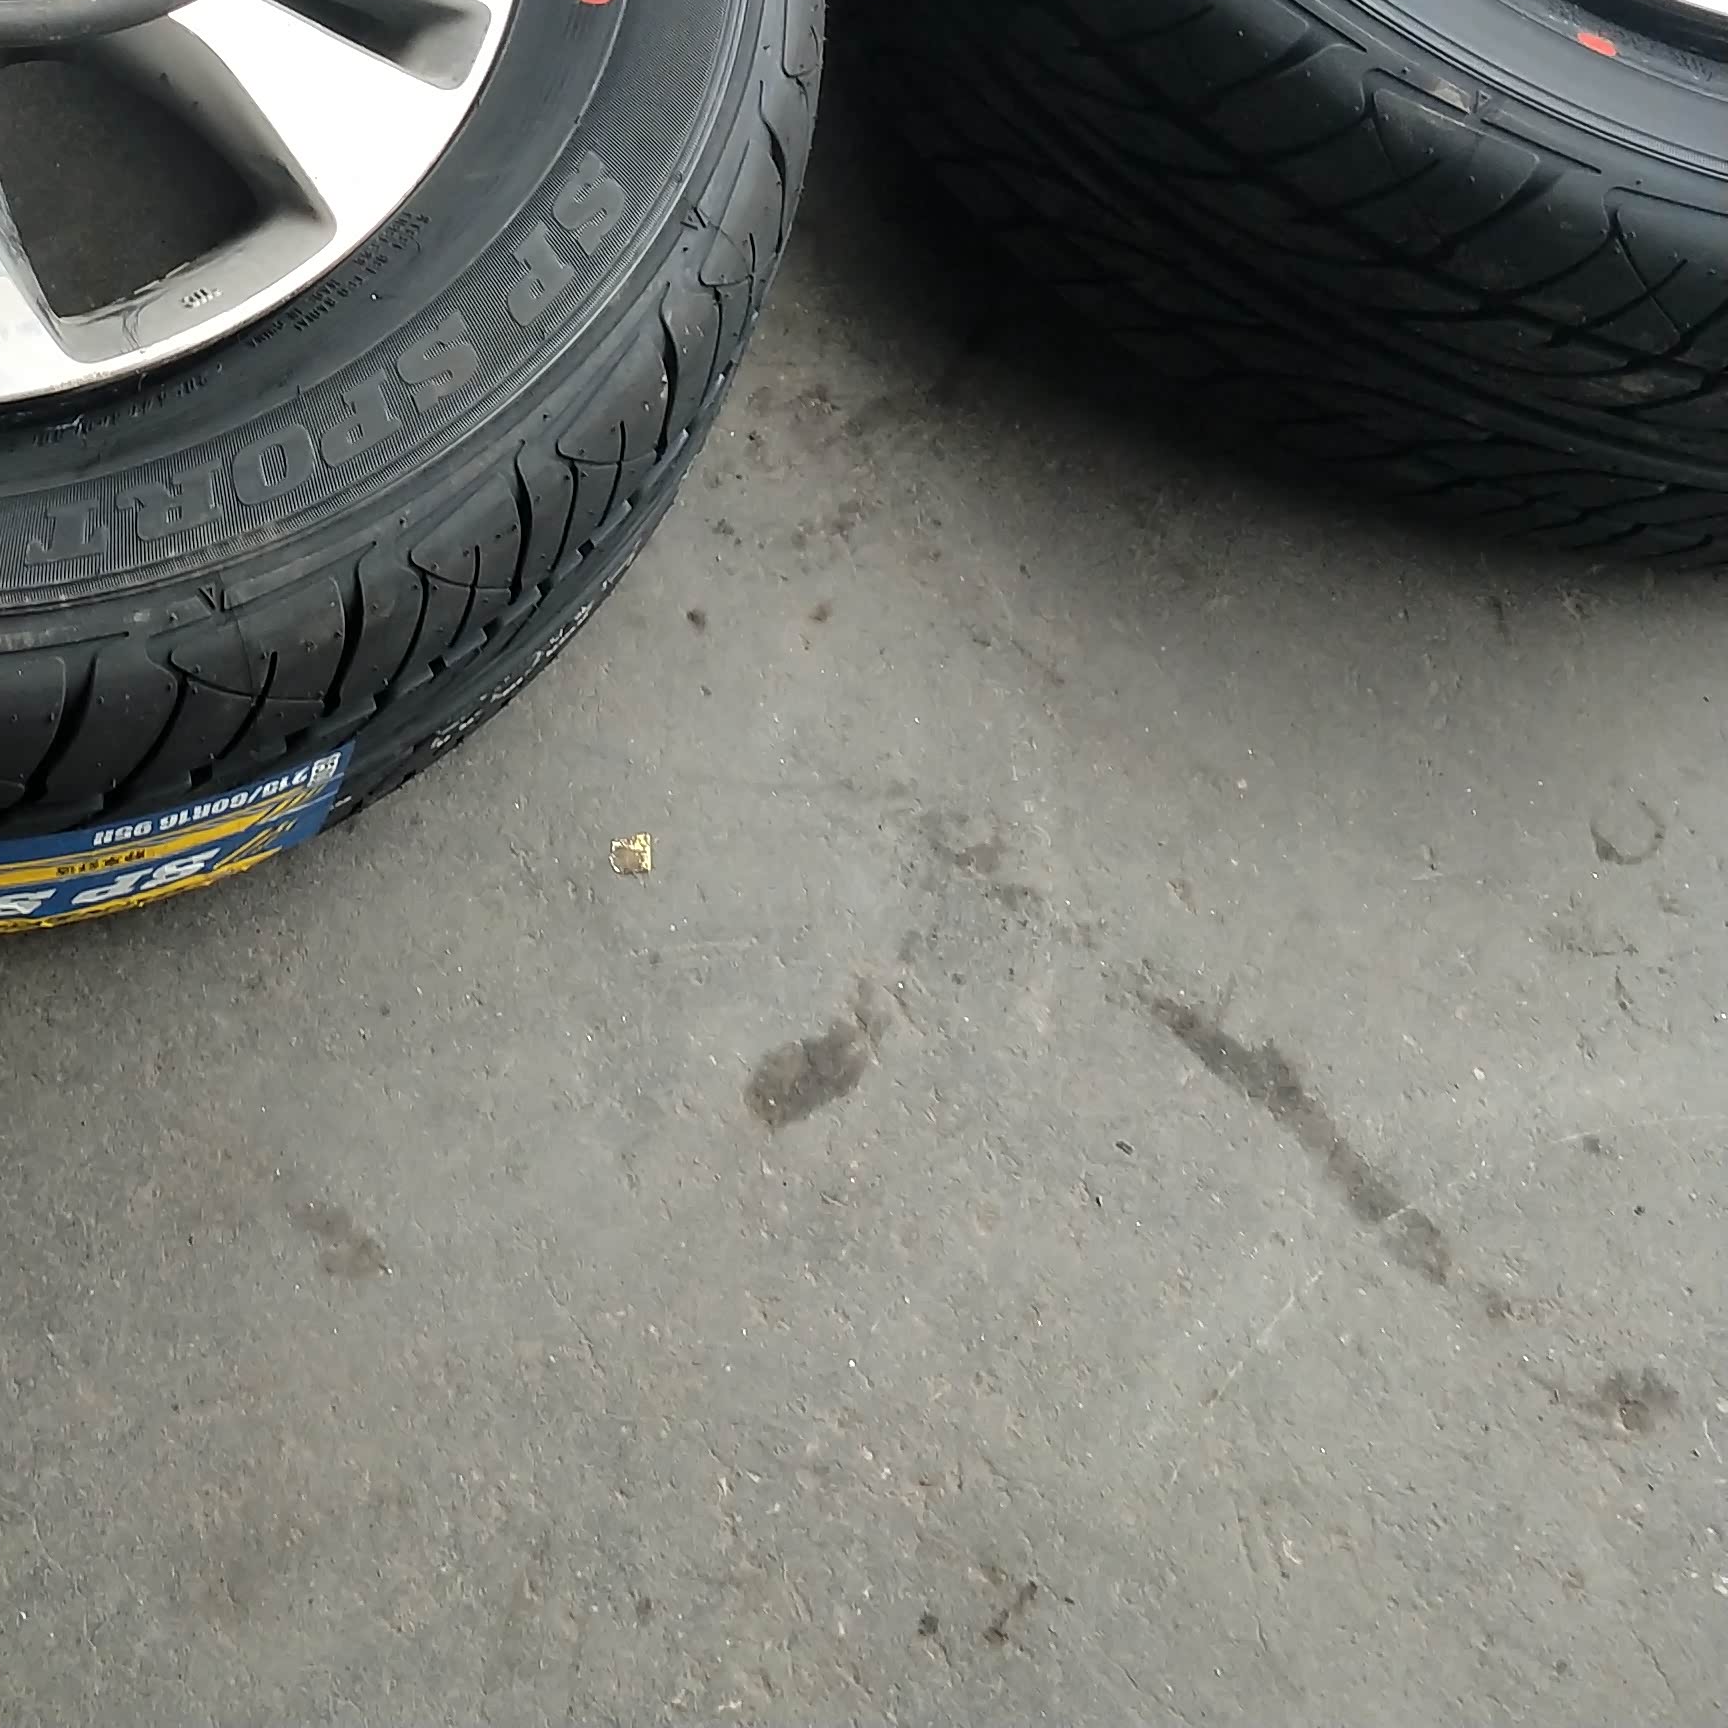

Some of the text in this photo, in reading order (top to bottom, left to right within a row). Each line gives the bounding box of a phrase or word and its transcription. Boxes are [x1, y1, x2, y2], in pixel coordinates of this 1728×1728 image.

[506, 150, 626, 327] SP
[24, 310, 479, 567] SPORT
[93, 771, 308, 846] 215/60R16 95H
[71, 847, 222, 906] SP
